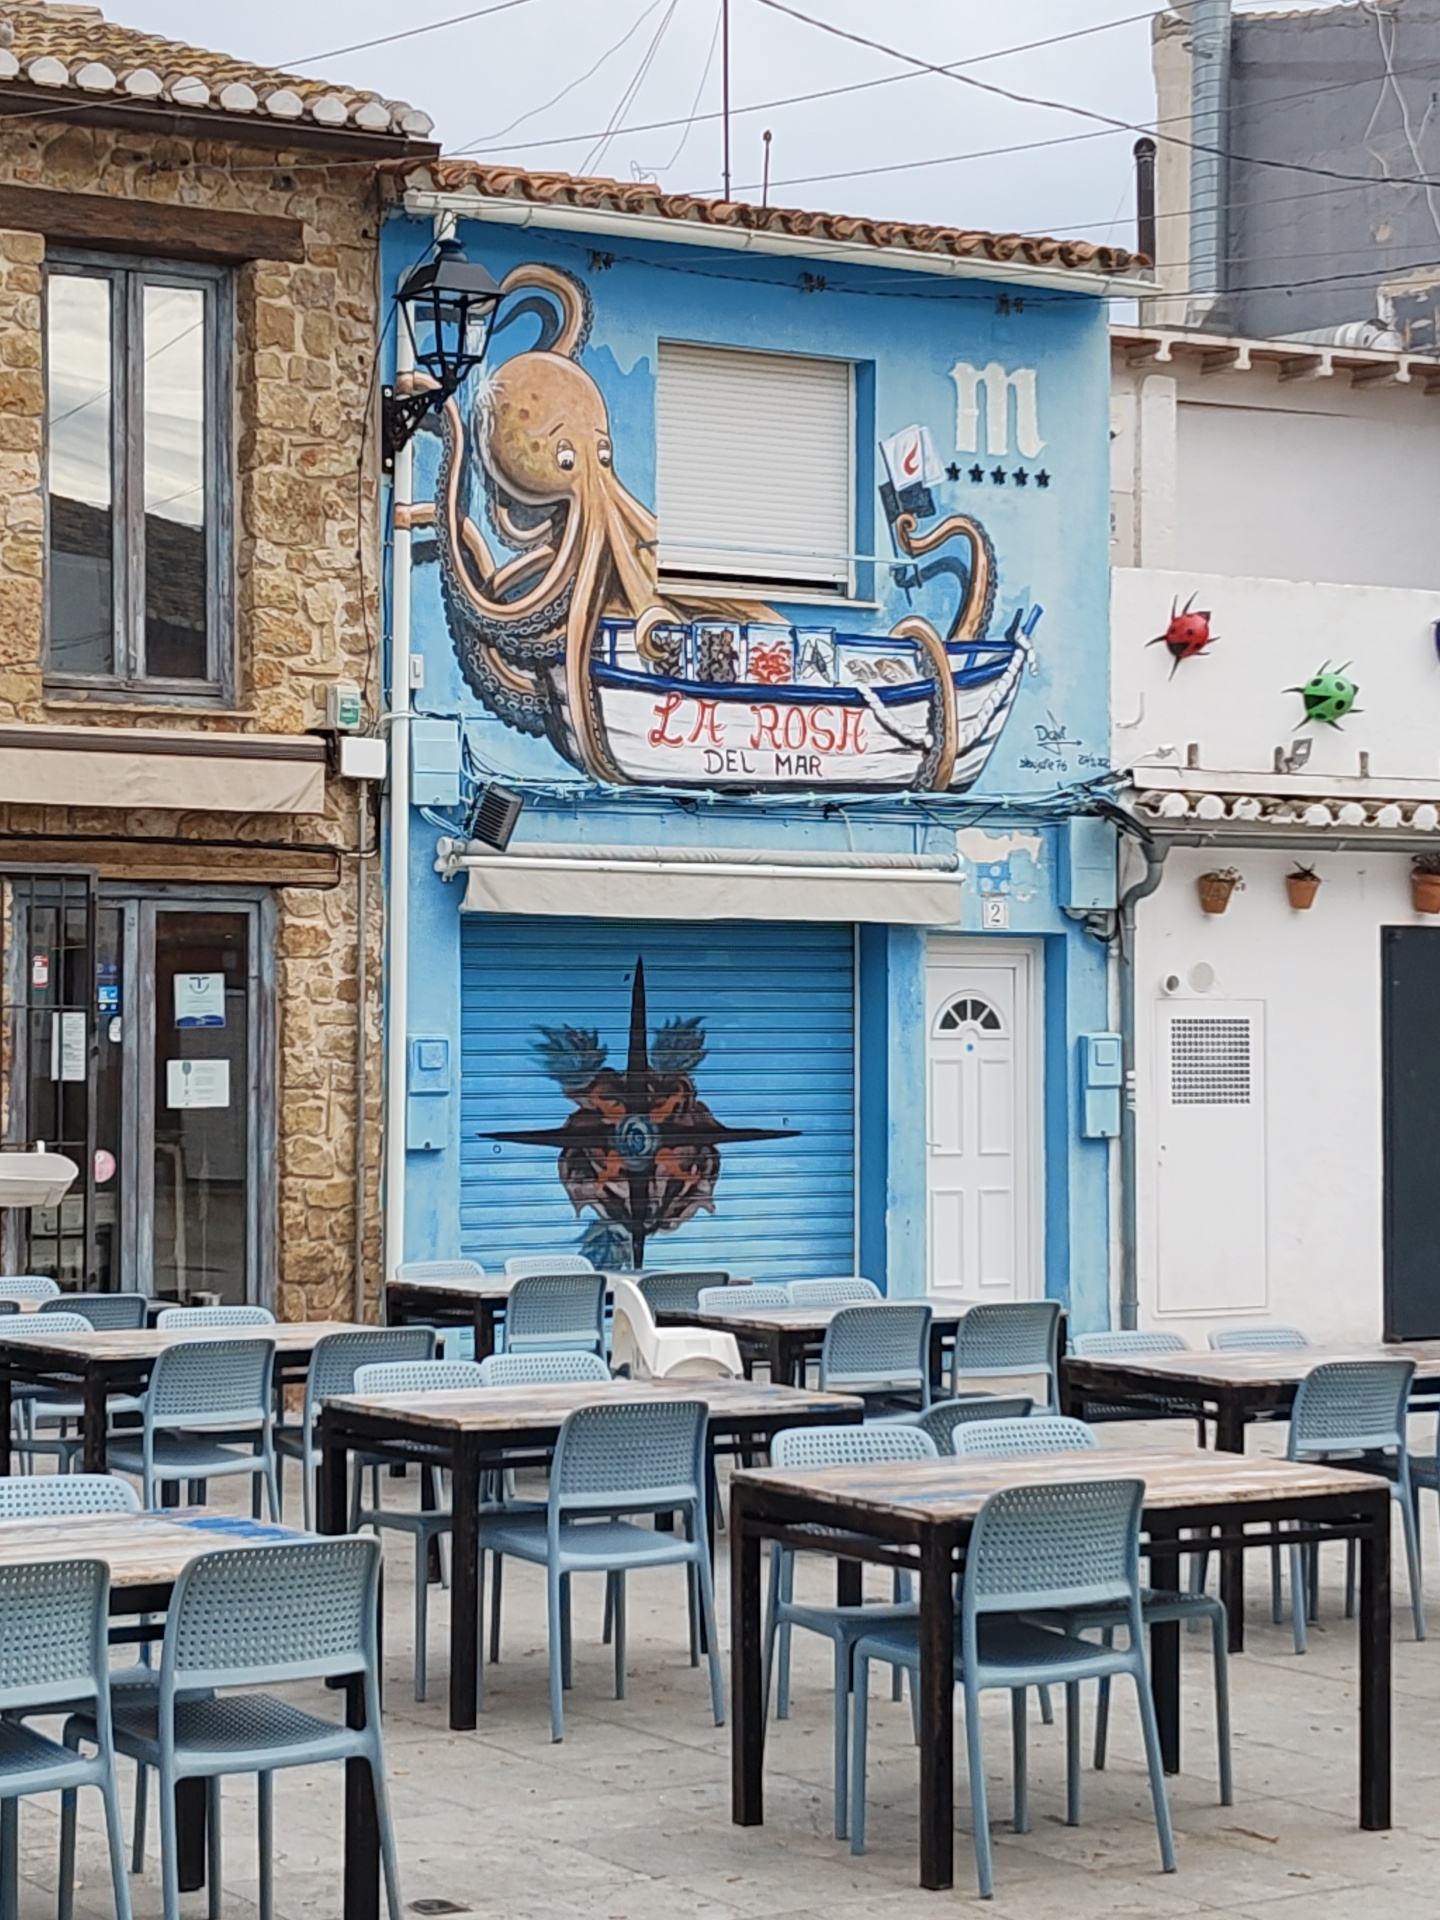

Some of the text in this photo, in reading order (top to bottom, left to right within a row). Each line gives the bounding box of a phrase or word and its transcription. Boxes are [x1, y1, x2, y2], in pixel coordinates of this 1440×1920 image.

[648, 691, 868, 755] LA ROSA
[704, 749, 823, 777] DEL MAR
[990, 904, 1001, 923] 2
